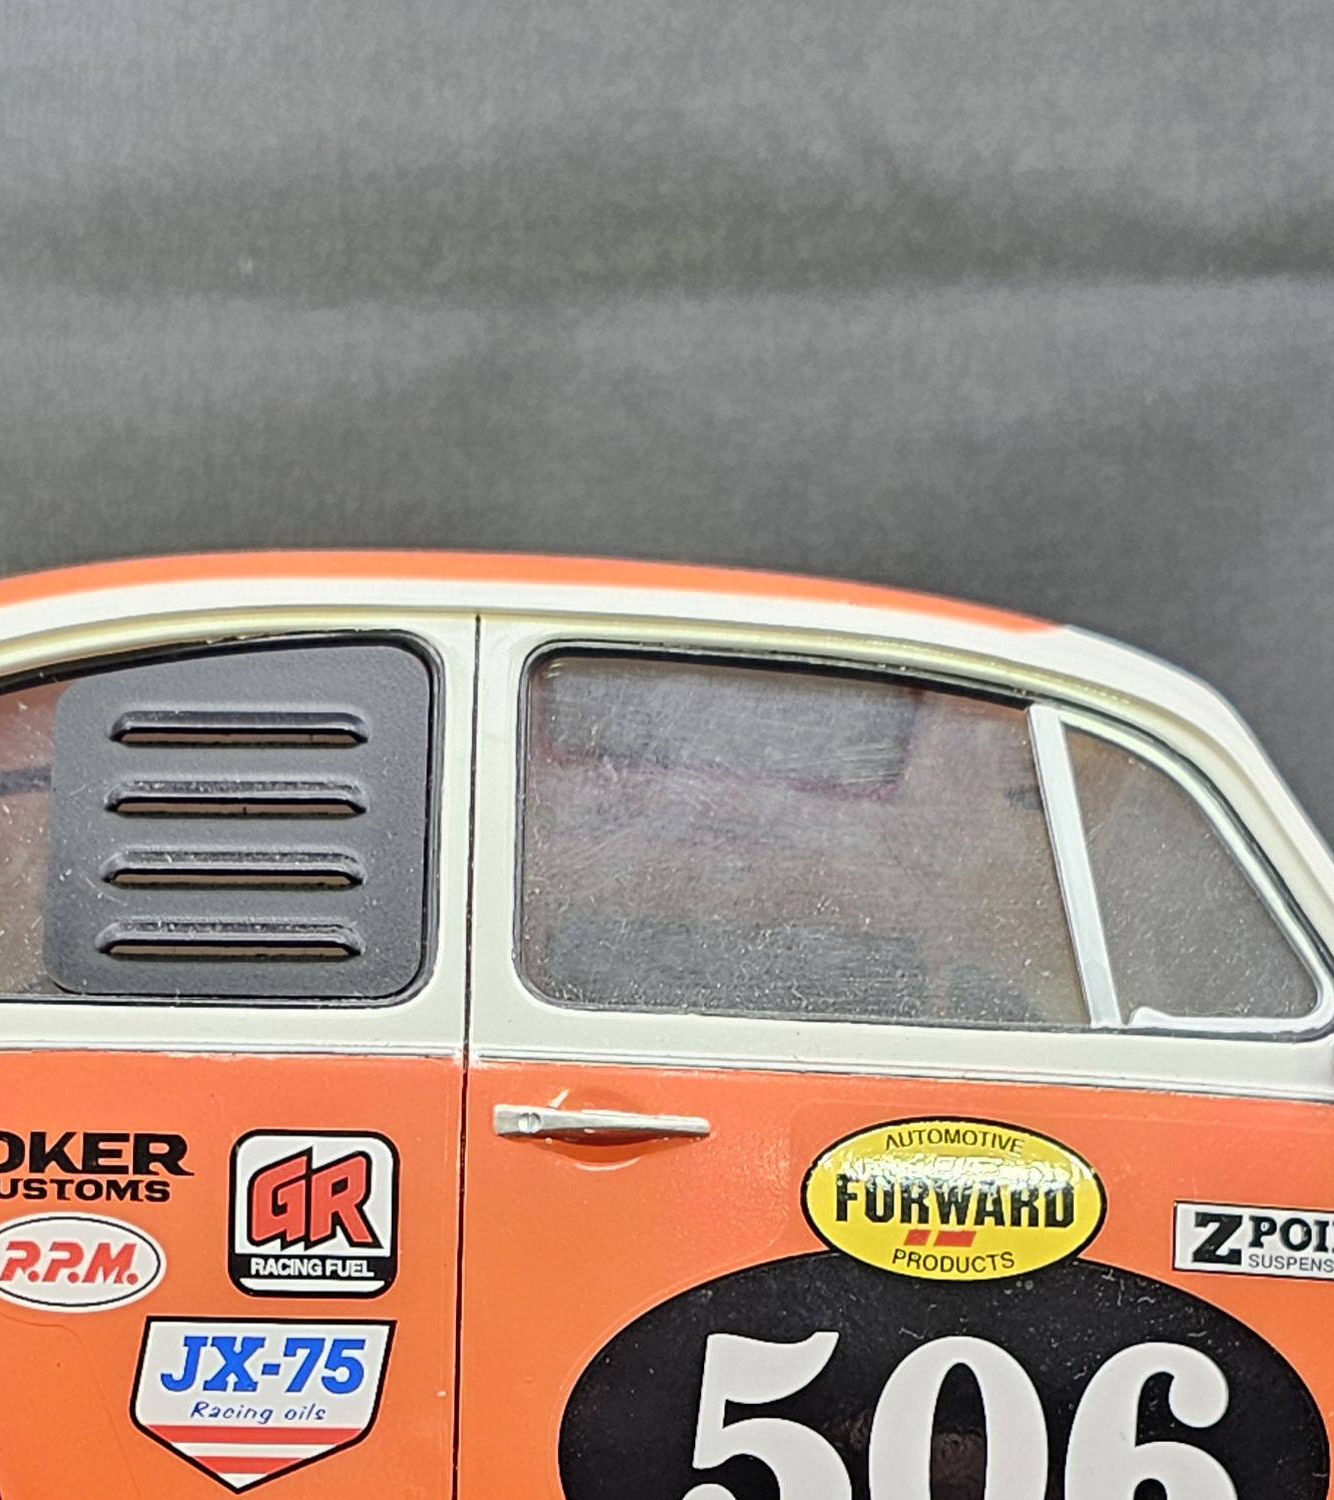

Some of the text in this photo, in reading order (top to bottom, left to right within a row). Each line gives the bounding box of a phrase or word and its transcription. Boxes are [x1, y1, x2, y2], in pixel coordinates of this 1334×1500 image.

[885, 1128, 1026, 1157] AUTOMOTIVE
[247, 1146, 384, 1252] GR
[835, 1171, 1075, 1229] FORWARD
[892, 1248, 1016, 1274] PRODUCTS
[1191, 1211, 1244, 1266] Z
[0, 1240, 139, 1285] R.P.M.
[250, 1257, 375, 1278] RACING FUEL
[160, 1335, 367, 1395] JX-75
[190, 1401, 327, 1425] Racing oils
